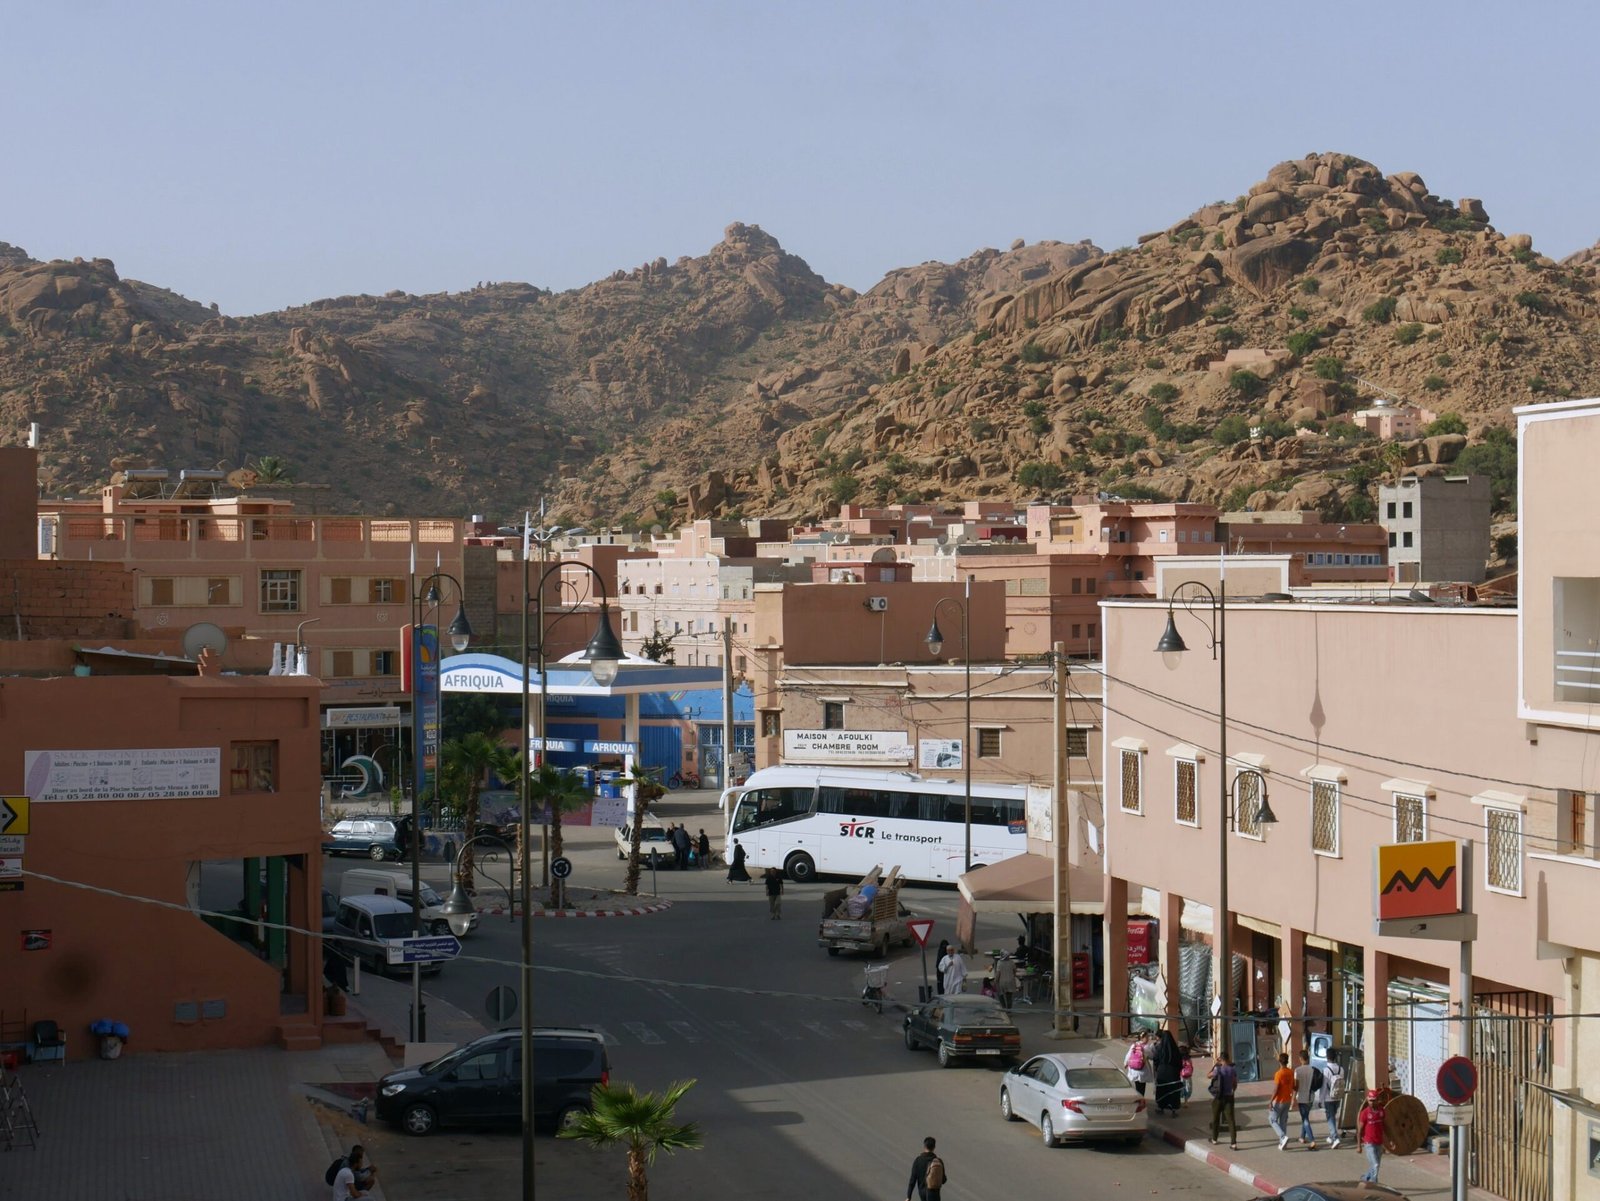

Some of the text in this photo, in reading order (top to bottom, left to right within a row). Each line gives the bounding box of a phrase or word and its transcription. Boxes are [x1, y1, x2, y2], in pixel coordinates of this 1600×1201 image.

[444, 674, 504, 690] AFRIQUIA
[797, 733, 827, 741] MAISON
[592, 742, 635, 753] AFRIQUIA
[881, 831, 892, 840] Le
[895, 832, 942, 844] transport
